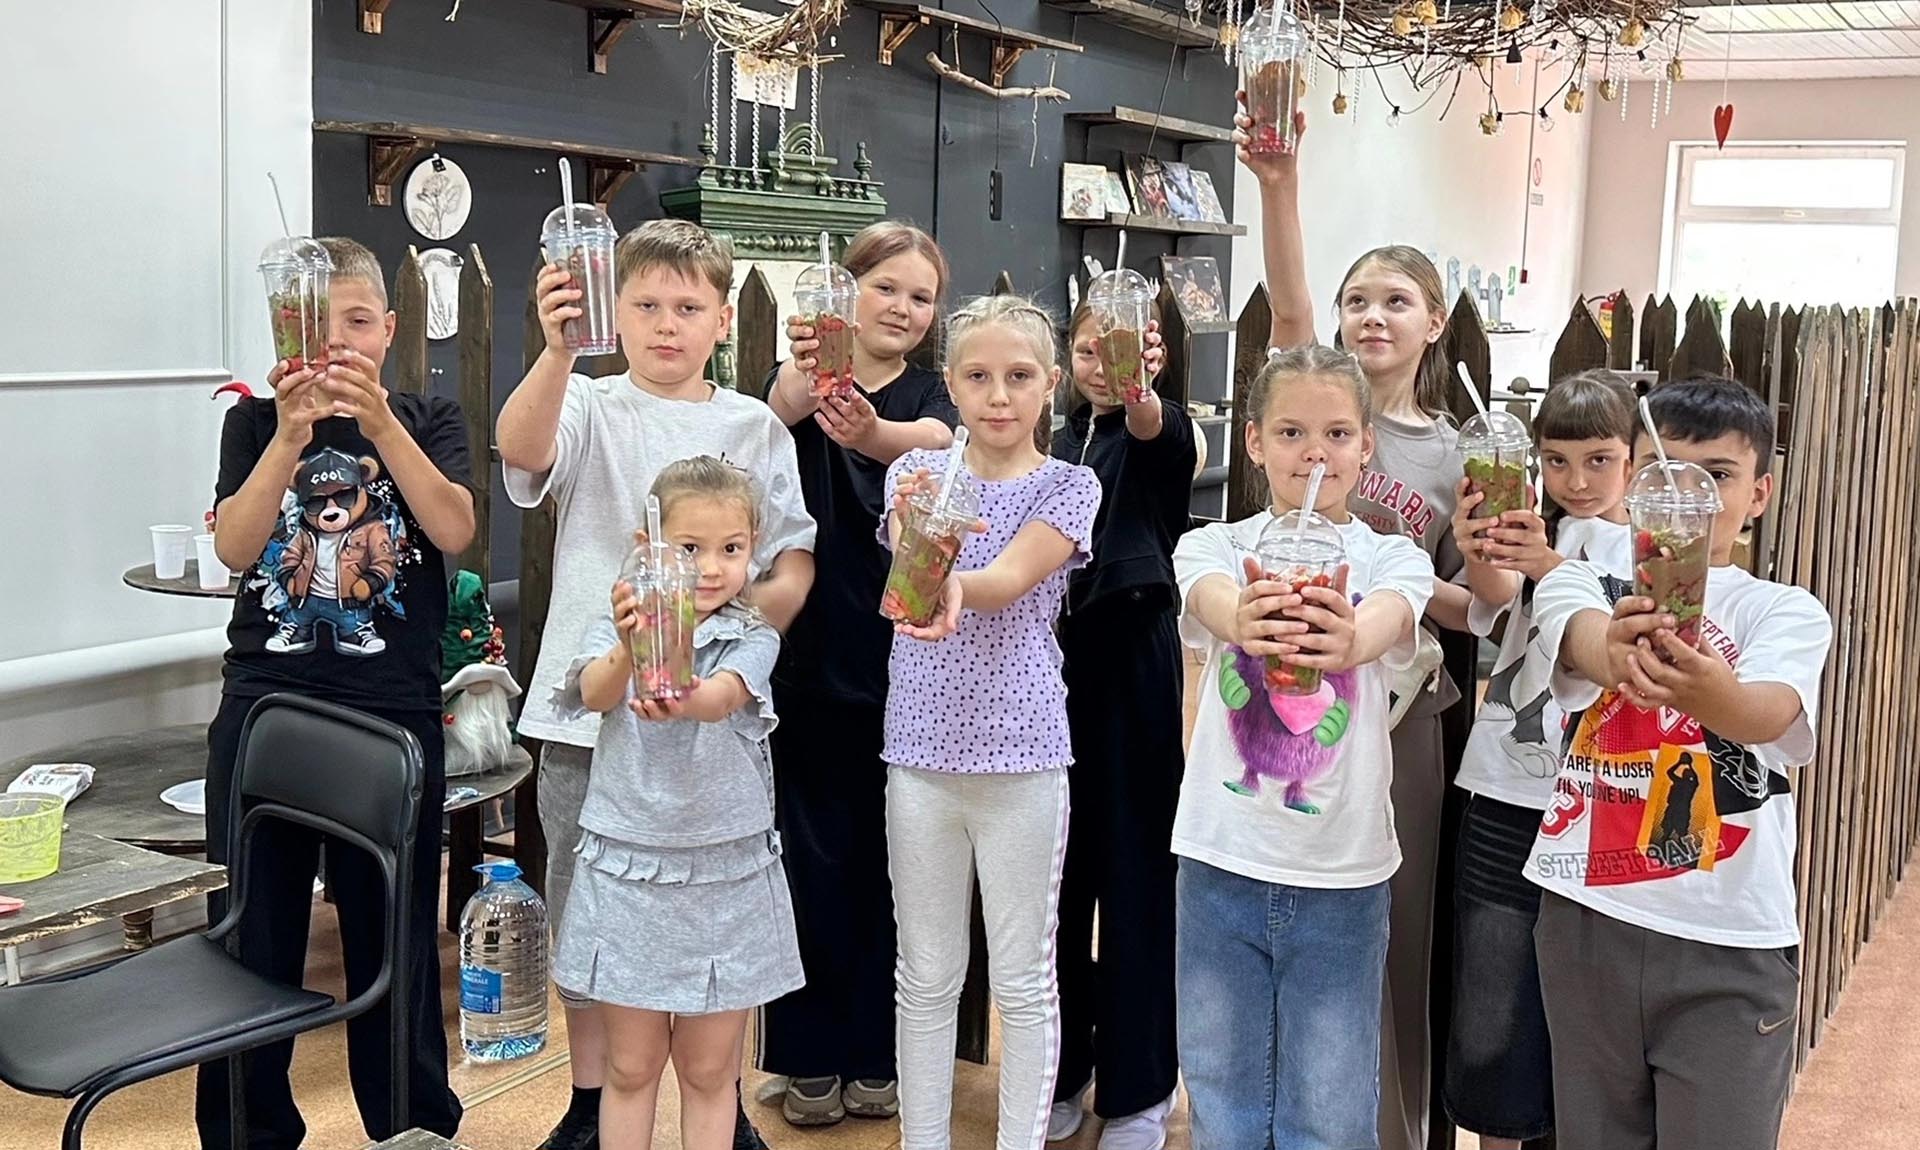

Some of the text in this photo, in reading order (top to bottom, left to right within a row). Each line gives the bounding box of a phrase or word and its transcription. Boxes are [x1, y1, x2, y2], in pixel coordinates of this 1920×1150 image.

[310, 469, 345, 484] COOL
[1713, 635, 1740, 671] FAIL
[1566, 754, 1592, 773] ARE
[1602, 760, 1612, 777] A
[1615, 762, 1655, 779] LOSER
[1578, 780, 1593, 799] YO
[1536, 827, 1727, 879] STREETBALL
